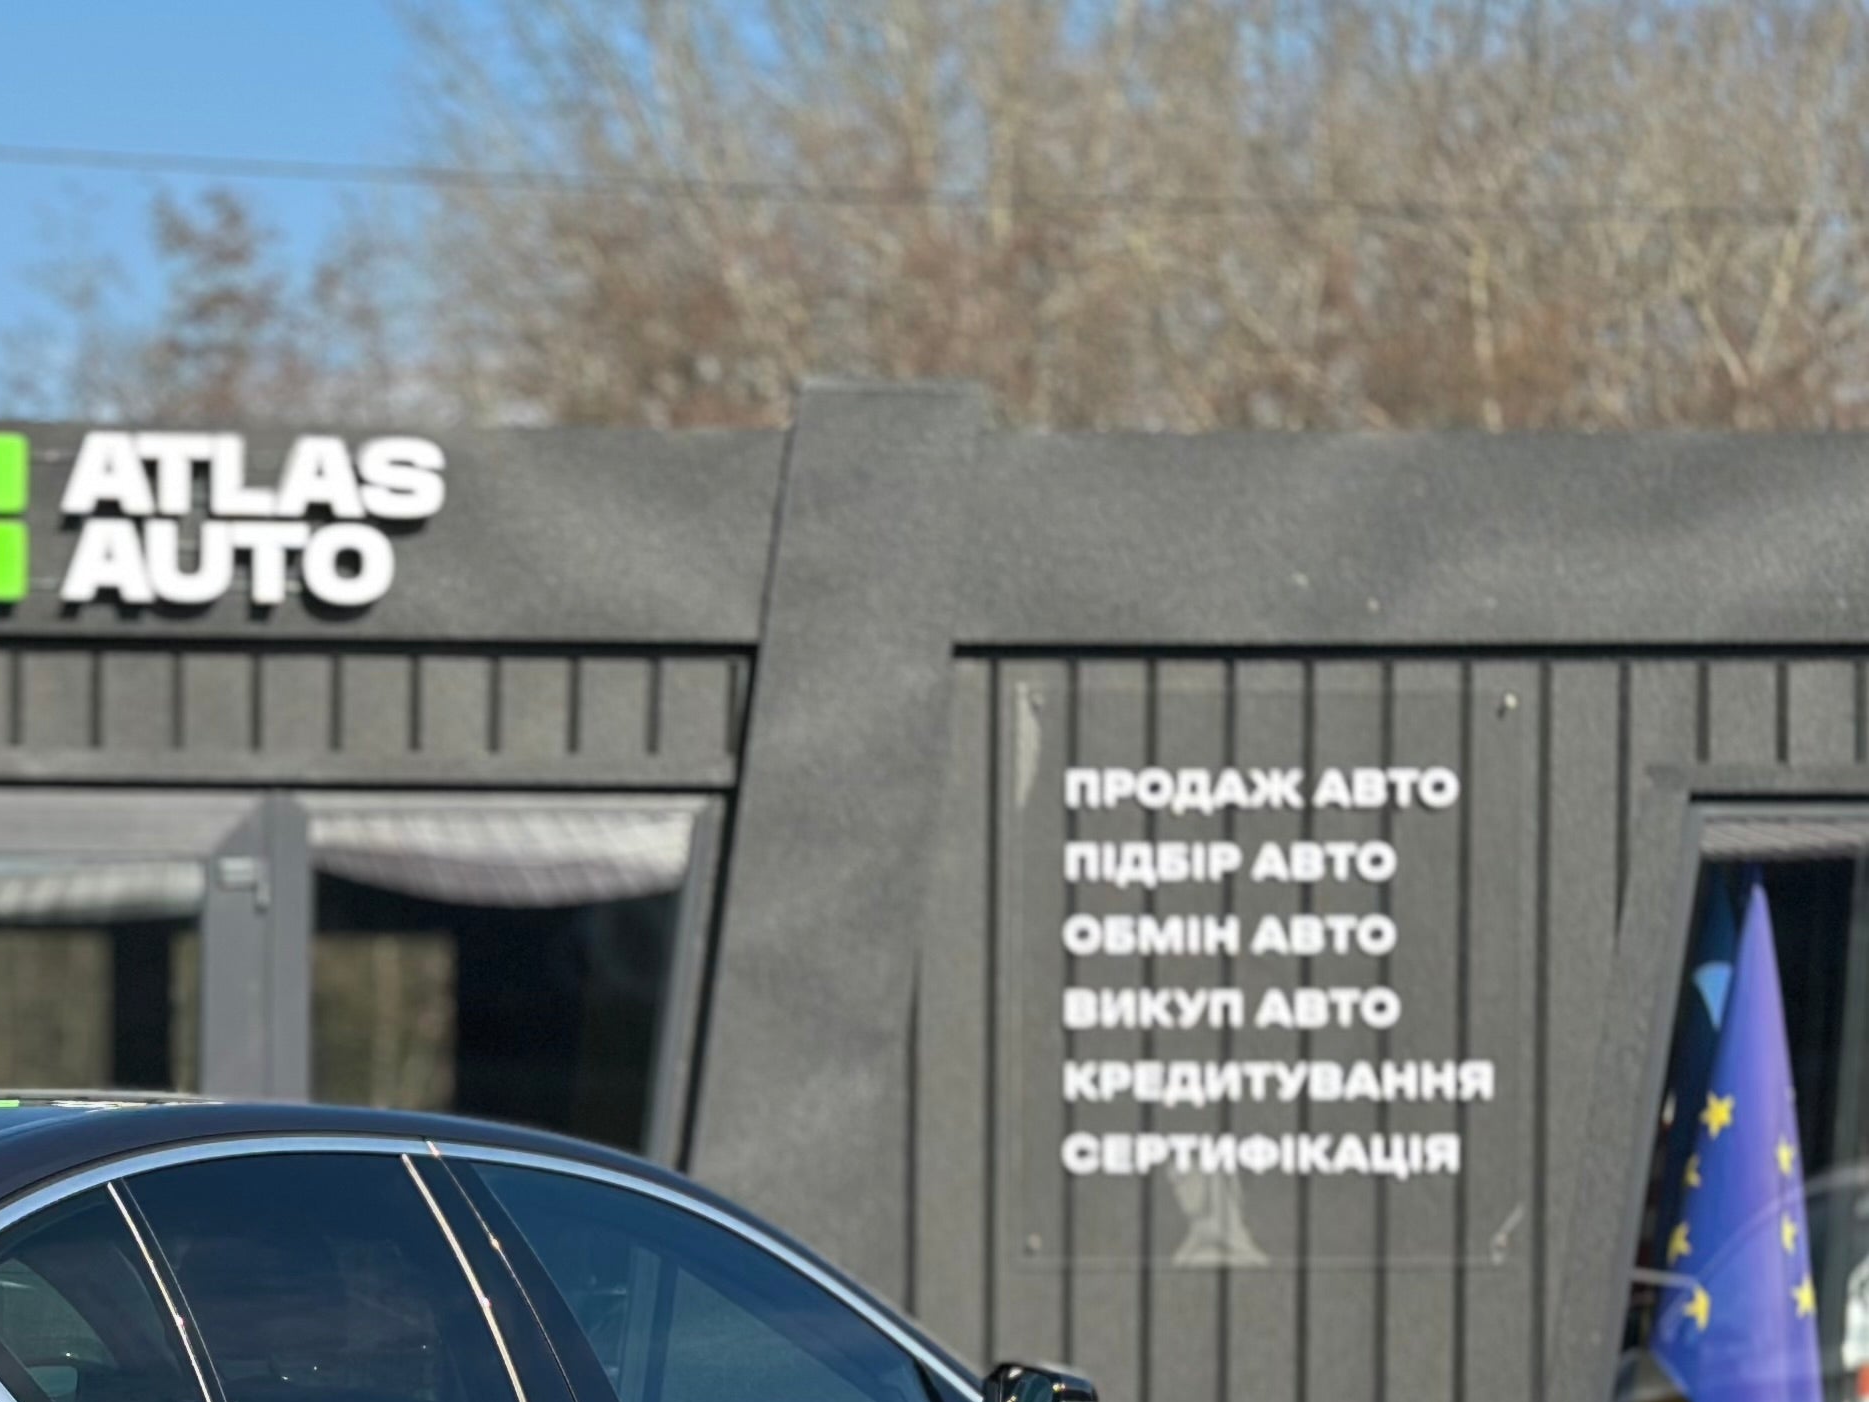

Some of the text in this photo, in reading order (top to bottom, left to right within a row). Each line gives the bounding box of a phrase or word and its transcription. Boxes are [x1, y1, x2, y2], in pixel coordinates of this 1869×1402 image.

[61, 430, 446, 518] ATLAS
[60, 518, 396, 606] AUTO
[1064, 766, 1460, 815] ПРОДАЖ АВТО
[1063, 841, 1398, 888] ПІДБІР АВТО
[1062, 913, 1398, 956] ОБМІН АВТО
[1062, 987, 1402, 1029] ВИКУП АВТО
[1062, 1060, 1496, 1108] КРЕДИТУВАННЯ
[1061, 1132, 1461, 1181] СЕРТИФІКАЦІЯ
